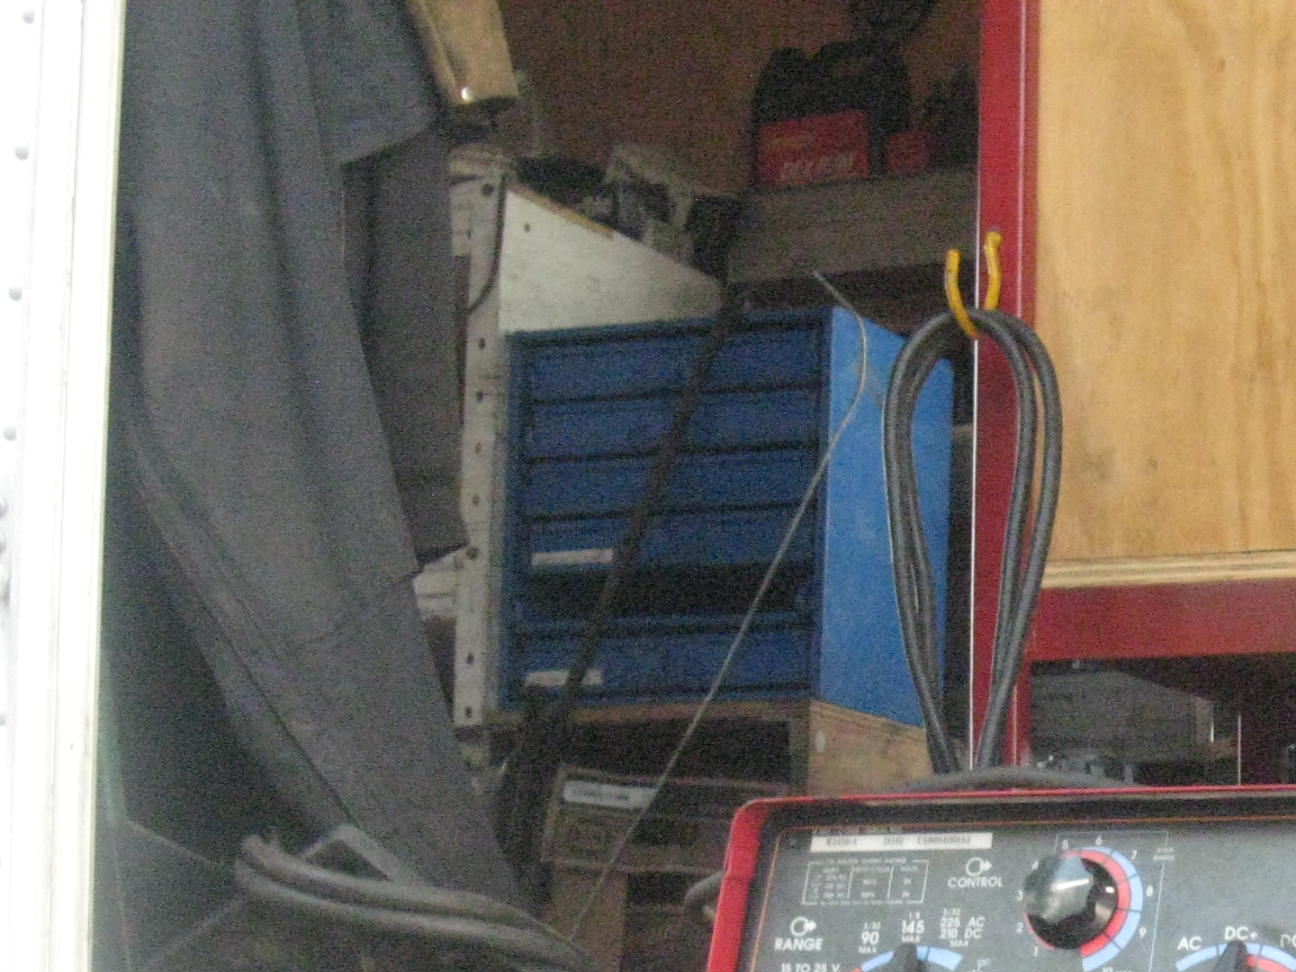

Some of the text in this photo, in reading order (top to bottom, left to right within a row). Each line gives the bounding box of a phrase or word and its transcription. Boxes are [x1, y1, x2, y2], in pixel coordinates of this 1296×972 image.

[1095, 836, 1103, 846] 6
[1131, 850, 1138, 860] 7
[947, 876, 1003, 888] CONTROL
[1016, 889, 1024, 901] 3
[1145, 884, 1154, 897] 8
[902, 920, 925, 934] 145
[967, 916, 985, 928] AC
[1016, 922, 1024, 934] 2
[860, 931, 880, 945] 90
[964, 927, 983, 939] DC
[1138, 927, 1146, 938] 9
[1224, 926, 1259, 941] DC+
[774, 937, 823, 951] RANGE
[1177, 936, 1203, 950] AC
